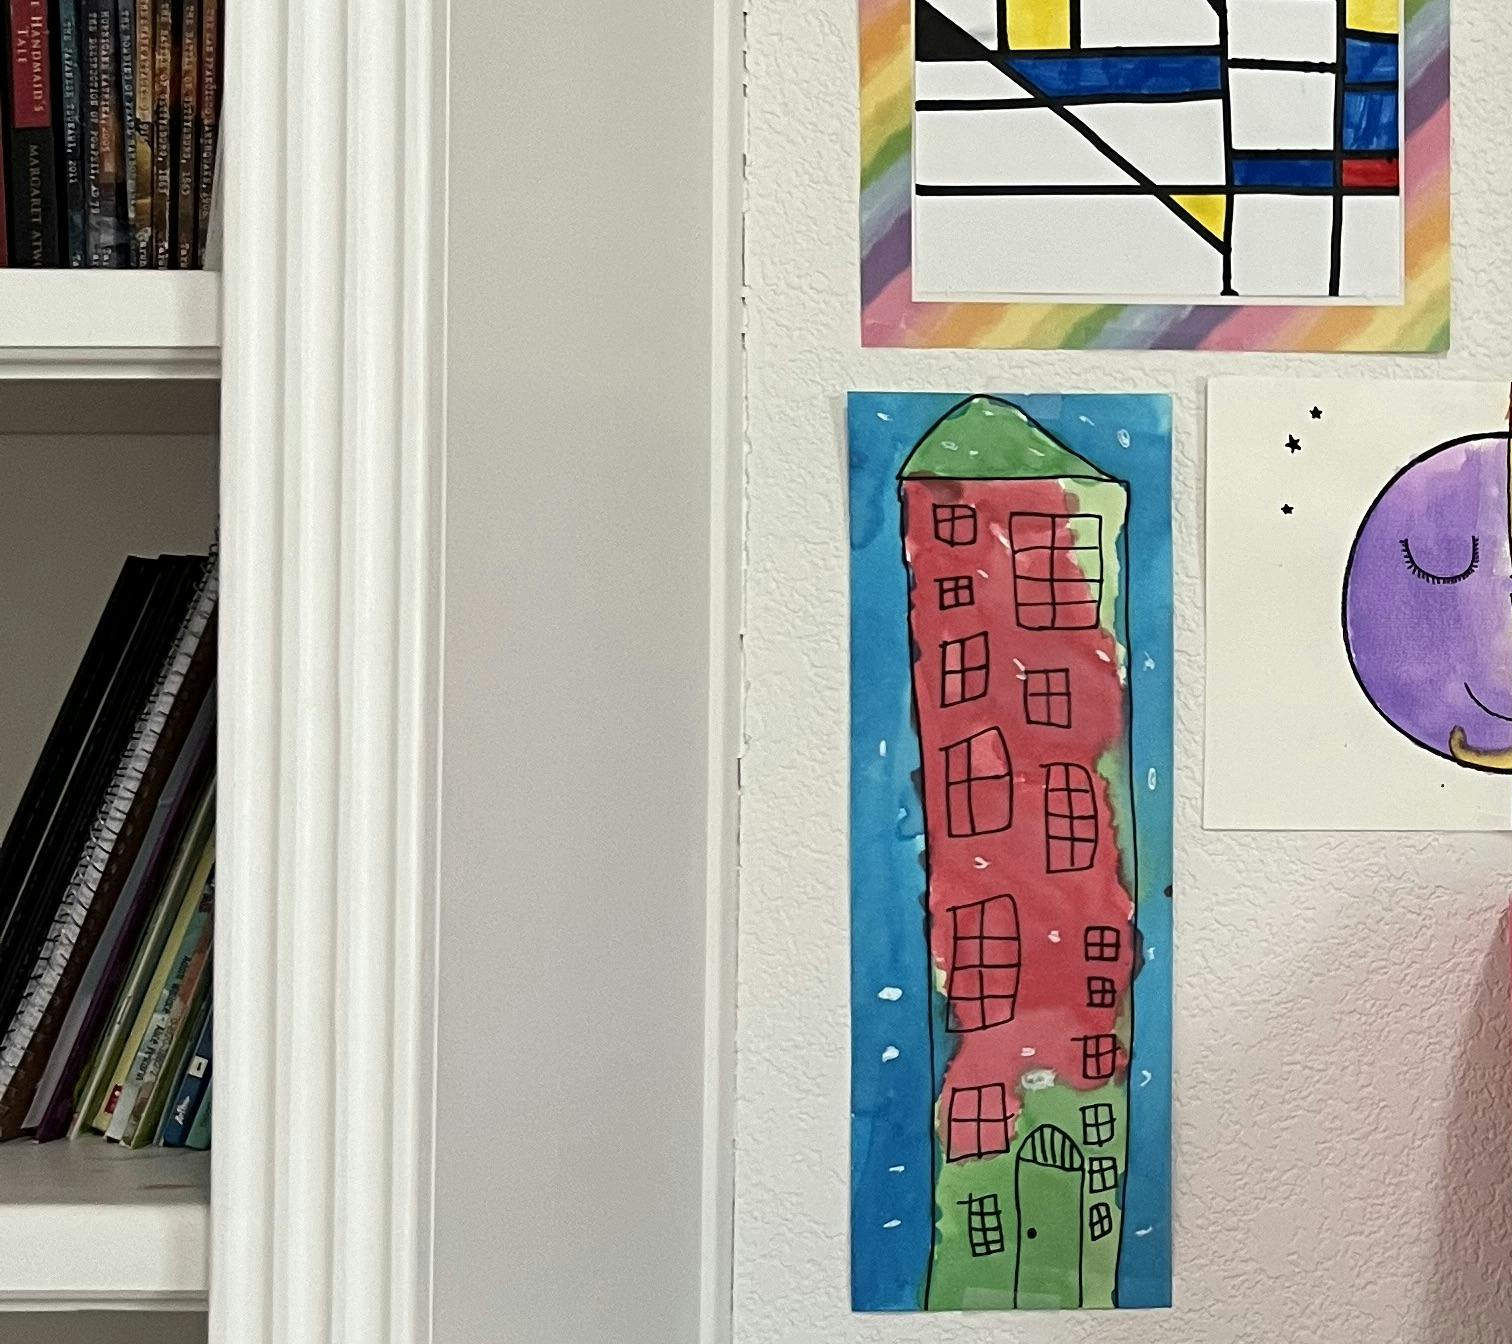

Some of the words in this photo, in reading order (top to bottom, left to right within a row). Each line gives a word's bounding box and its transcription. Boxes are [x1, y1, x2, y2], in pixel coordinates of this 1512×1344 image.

[16, 27, 28, 63] TALE
[31, 16, 46, 112] HANDMAID'S
[29, 144, 42, 224] MARGARET
